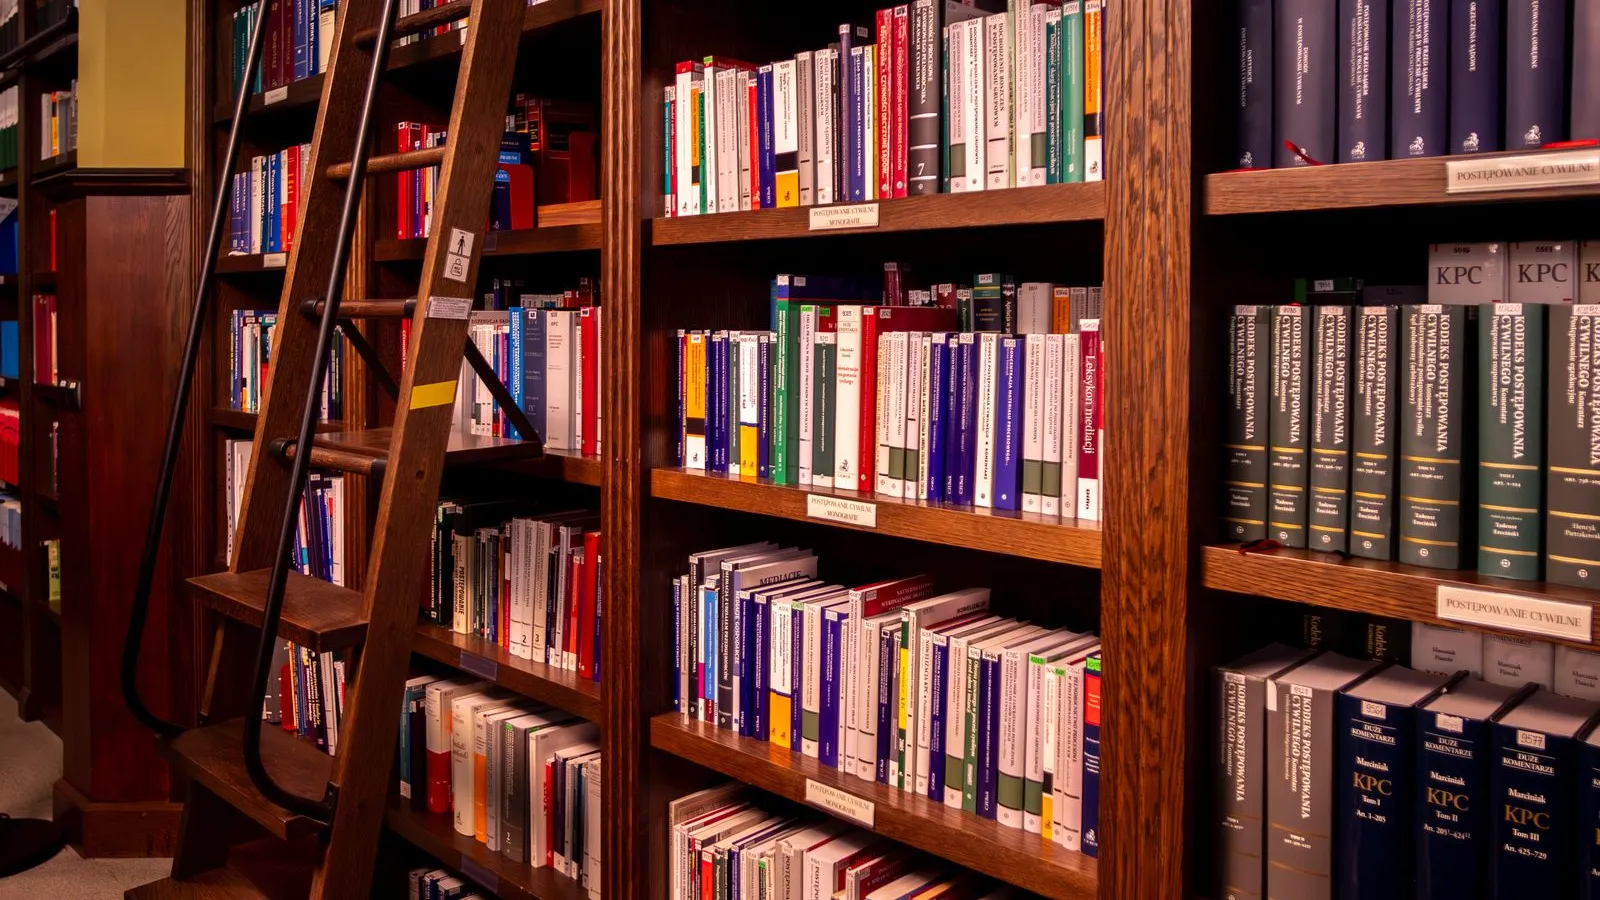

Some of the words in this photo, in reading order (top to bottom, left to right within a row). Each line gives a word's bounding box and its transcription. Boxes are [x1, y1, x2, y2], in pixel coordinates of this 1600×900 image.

[1468, 44, 1476, 72] SĄDOWE
[1530, 37, 1538, 69] ODRĘBNE
[917, 163, 926, 176] 7
[1457, 166, 1539, 181] POSTĘPOWANIE
[1541, 164, 1594, 175] CYWILNE
[829, 218, 860, 226] MONOGRAFIE
[1436, 266, 1482, 285] KPC
[1517, 263, 1568, 283] KPC
[1237, 315, 1245, 375] CYWILNEGO
[1247, 316, 1255, 357] KODEKS
[1282, 316, 1290, 377] CYWILNEGO
[1292, 317, 1301, 358] KODEKS
[1325, 315, 1334, 377] CYWILNEGO
[1337, 315, 1346, 358] KODEKS
[1367, 315, 1376, 379] CYWILNEGO
[1378, 315, 1387, 358] KODEKS
[1427, 314, 1437, 380] CYWILNEGO
[1440, 314, 1450, 359] KODEKS
[1502, 315, 1511, 385] CYWILNEGO
[1515, 316, 1524, 363] KODEKS
[1083, 355, 1096, 406] Leksykon
[1244, 360, 1254, 440] POSTĘPOWANIA
[1289, 361, 1300, 443] POSTĘPOWANIA
[1333, 361, 1345, 444] POSTĘPOWANIA
[1374, 361, 1386, 446] POSTĘPOWANIA
[1436, 363, 1449, 452] POSTĘPOWANIA
[1510, 366, 1524, 459] POSTĘPOWANIA
[1082, 408, 1095, 454] mediacji
[759, 571, 802, 585] MEDIACJE
[1447, 598, 1528, 619] POSTĘPOWANIE
[1530, 611, 1582, 627] CYWILNE
[1227, 683, 1236, 742] CYWILNEGO
[1238, 685, 1246, 723] KODEKS
[1302, 698, 1312, 738] KODEKS
[1292, 695, 1301, 757] CYWILNEGO
[1351, 728, 1396, 744] KOMENTARZE
[1235, 725, 1245, 801] POSTĘPOWANIA
[1356, 756, 1389, 772] Marciniak
[1424, 742, 1473, 757] KOMENTARZE
[1503, 757, 1555, 774] KOMENTARZE
[1300, 740, 1311, 819] POSTĘPOWANIA
[1353, 771, 1393, 796] KPC
[1430, 770, 1466, 787] Marciniak
[1508, 788, 1547, 804] Marciniak
[826, 799, 856, 816] MONOGRAFIE
[847, 797, 870, 811] CYWILNE
[1362, 794, 1377, 806] Tom
[1427, 786, 1469, 812] KPC
[1435, 810, 1452, 820] Tom
[1504, 803, 1551, 830] KPC
[1512, 828, 1529, 839] Tom
[1530, 832, 1540, 842] III
